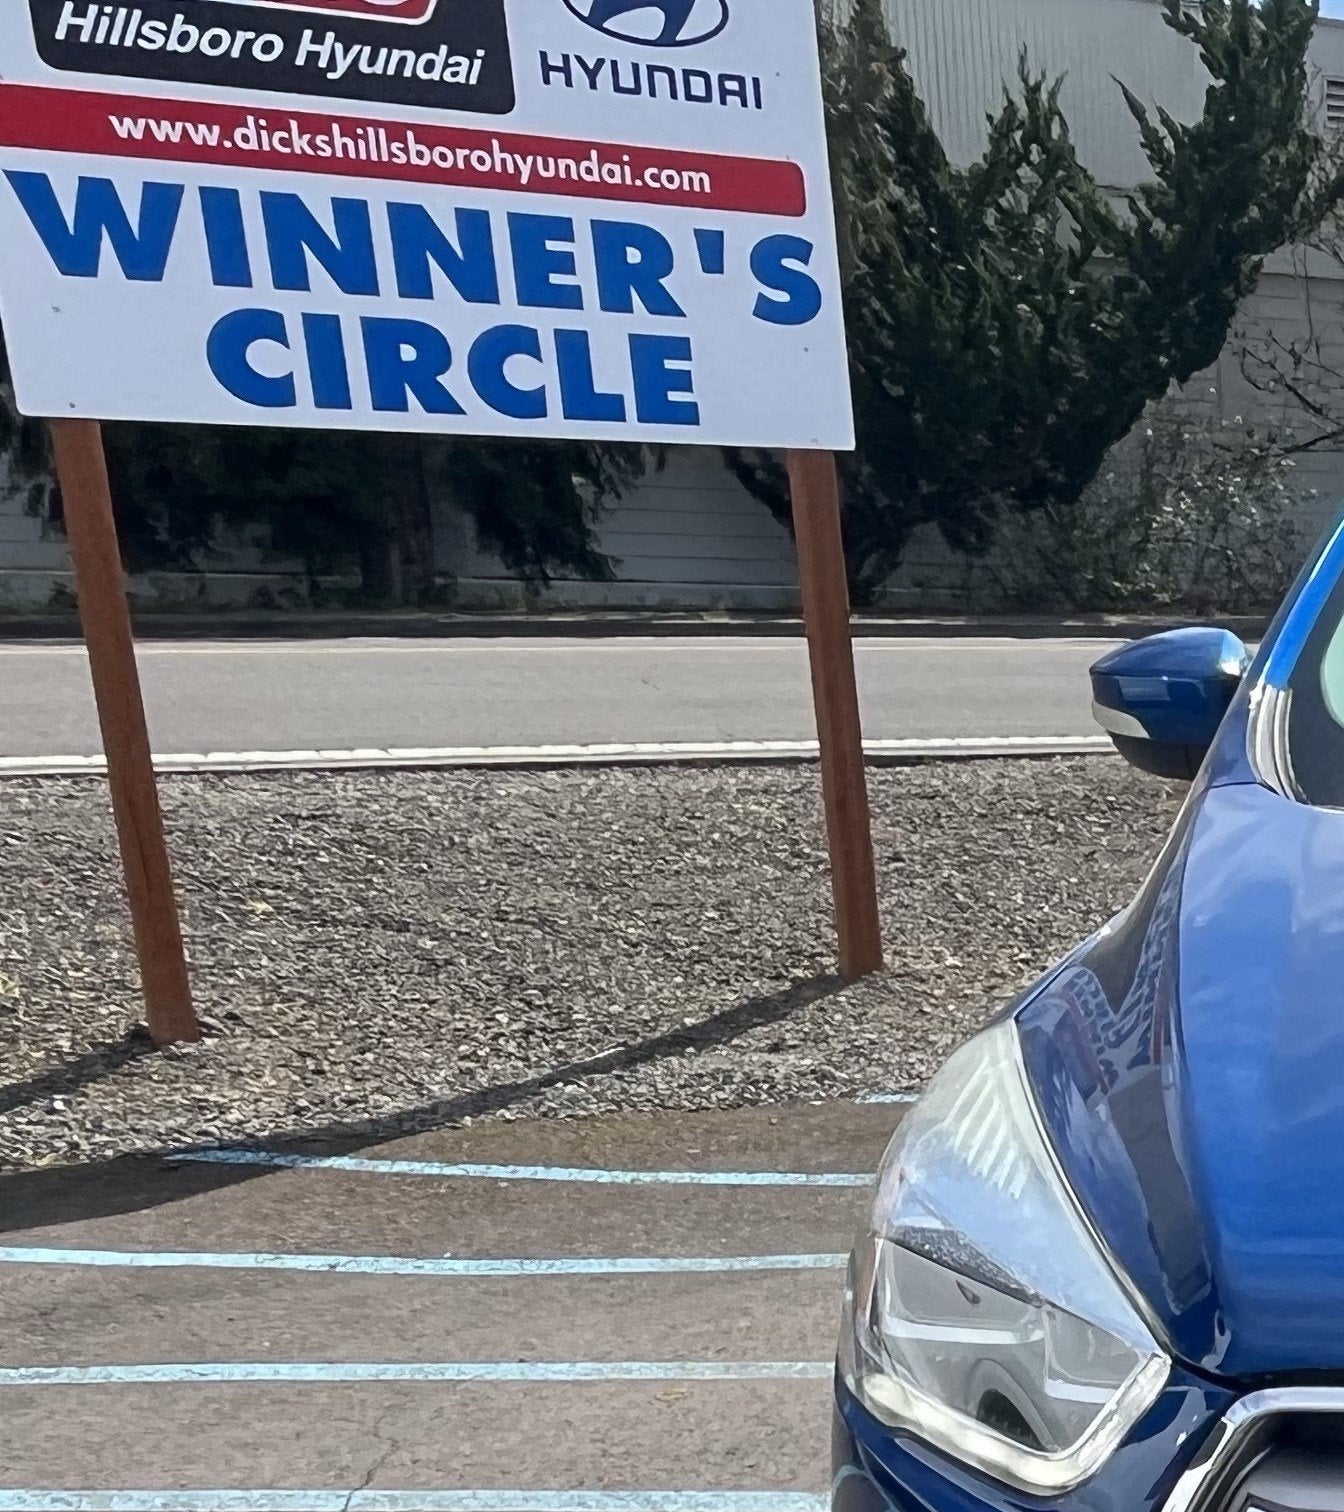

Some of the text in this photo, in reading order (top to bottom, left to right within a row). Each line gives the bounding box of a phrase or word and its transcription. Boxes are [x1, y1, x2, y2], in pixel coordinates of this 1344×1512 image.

[54, 2, 486, 85] Hillsboro Hyundai
[540, 50, 763, 110] HYUNDAI
[109, 113, 712, 194] www.dickshillsborohyundai.com
[2, 170, 823, 326] WINNER'S
[206, 308, 701, 426] CIRCLE
